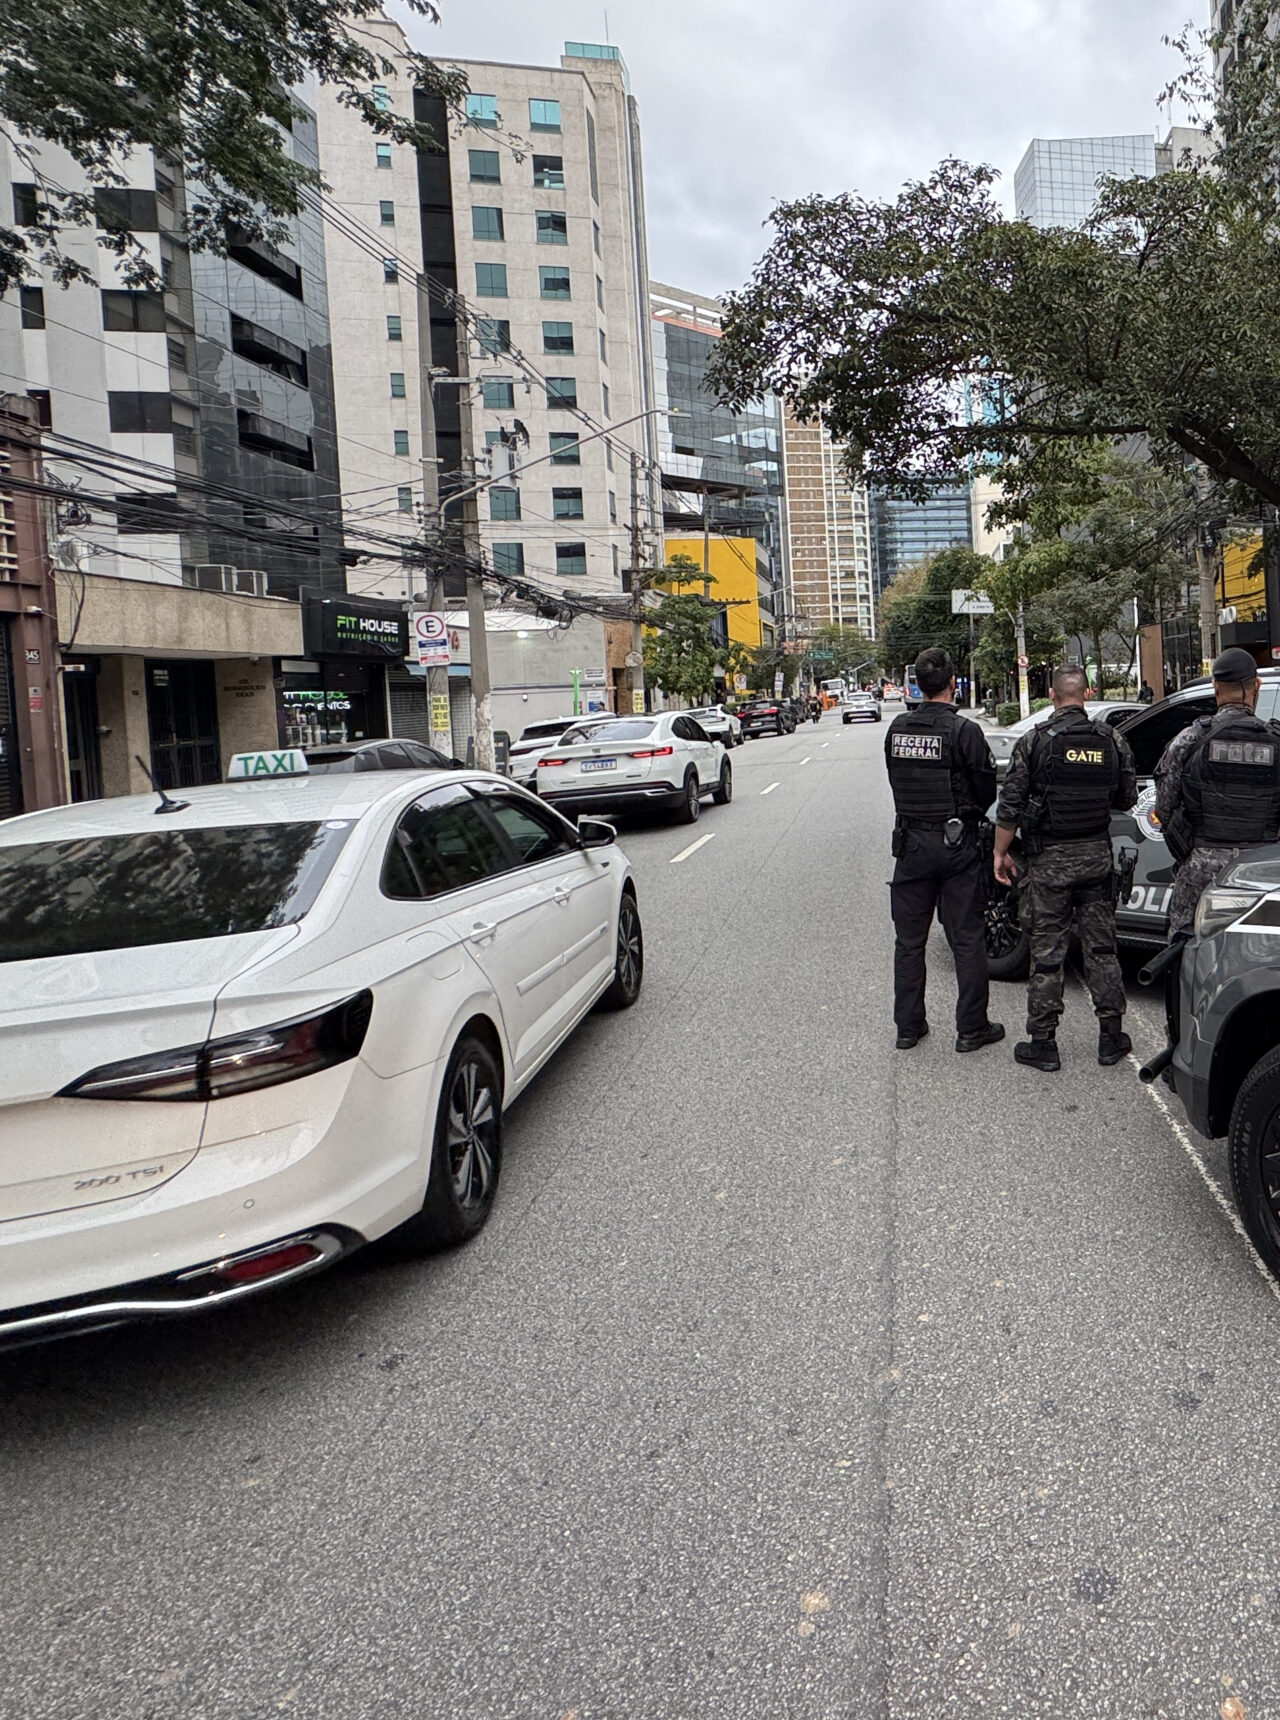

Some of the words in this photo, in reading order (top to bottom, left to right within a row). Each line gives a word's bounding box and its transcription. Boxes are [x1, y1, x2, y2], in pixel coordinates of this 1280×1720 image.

[337, 615, 357, 629] FIT
[360, 618, 399, 634] HOUSE
[425, 620, 436, 633] E
[894, 736, 939, 748] RECEITA
[894, 746, 938, 758] FEDERAL
[1066, 749, 1102, 762] GATE
[237, 752, 294, 776] TAXI
[1119, 885, 1173, 912] OLI
[73, 1175, 121, 1191] 200
[126, 1165, 164, 1179] TSI
